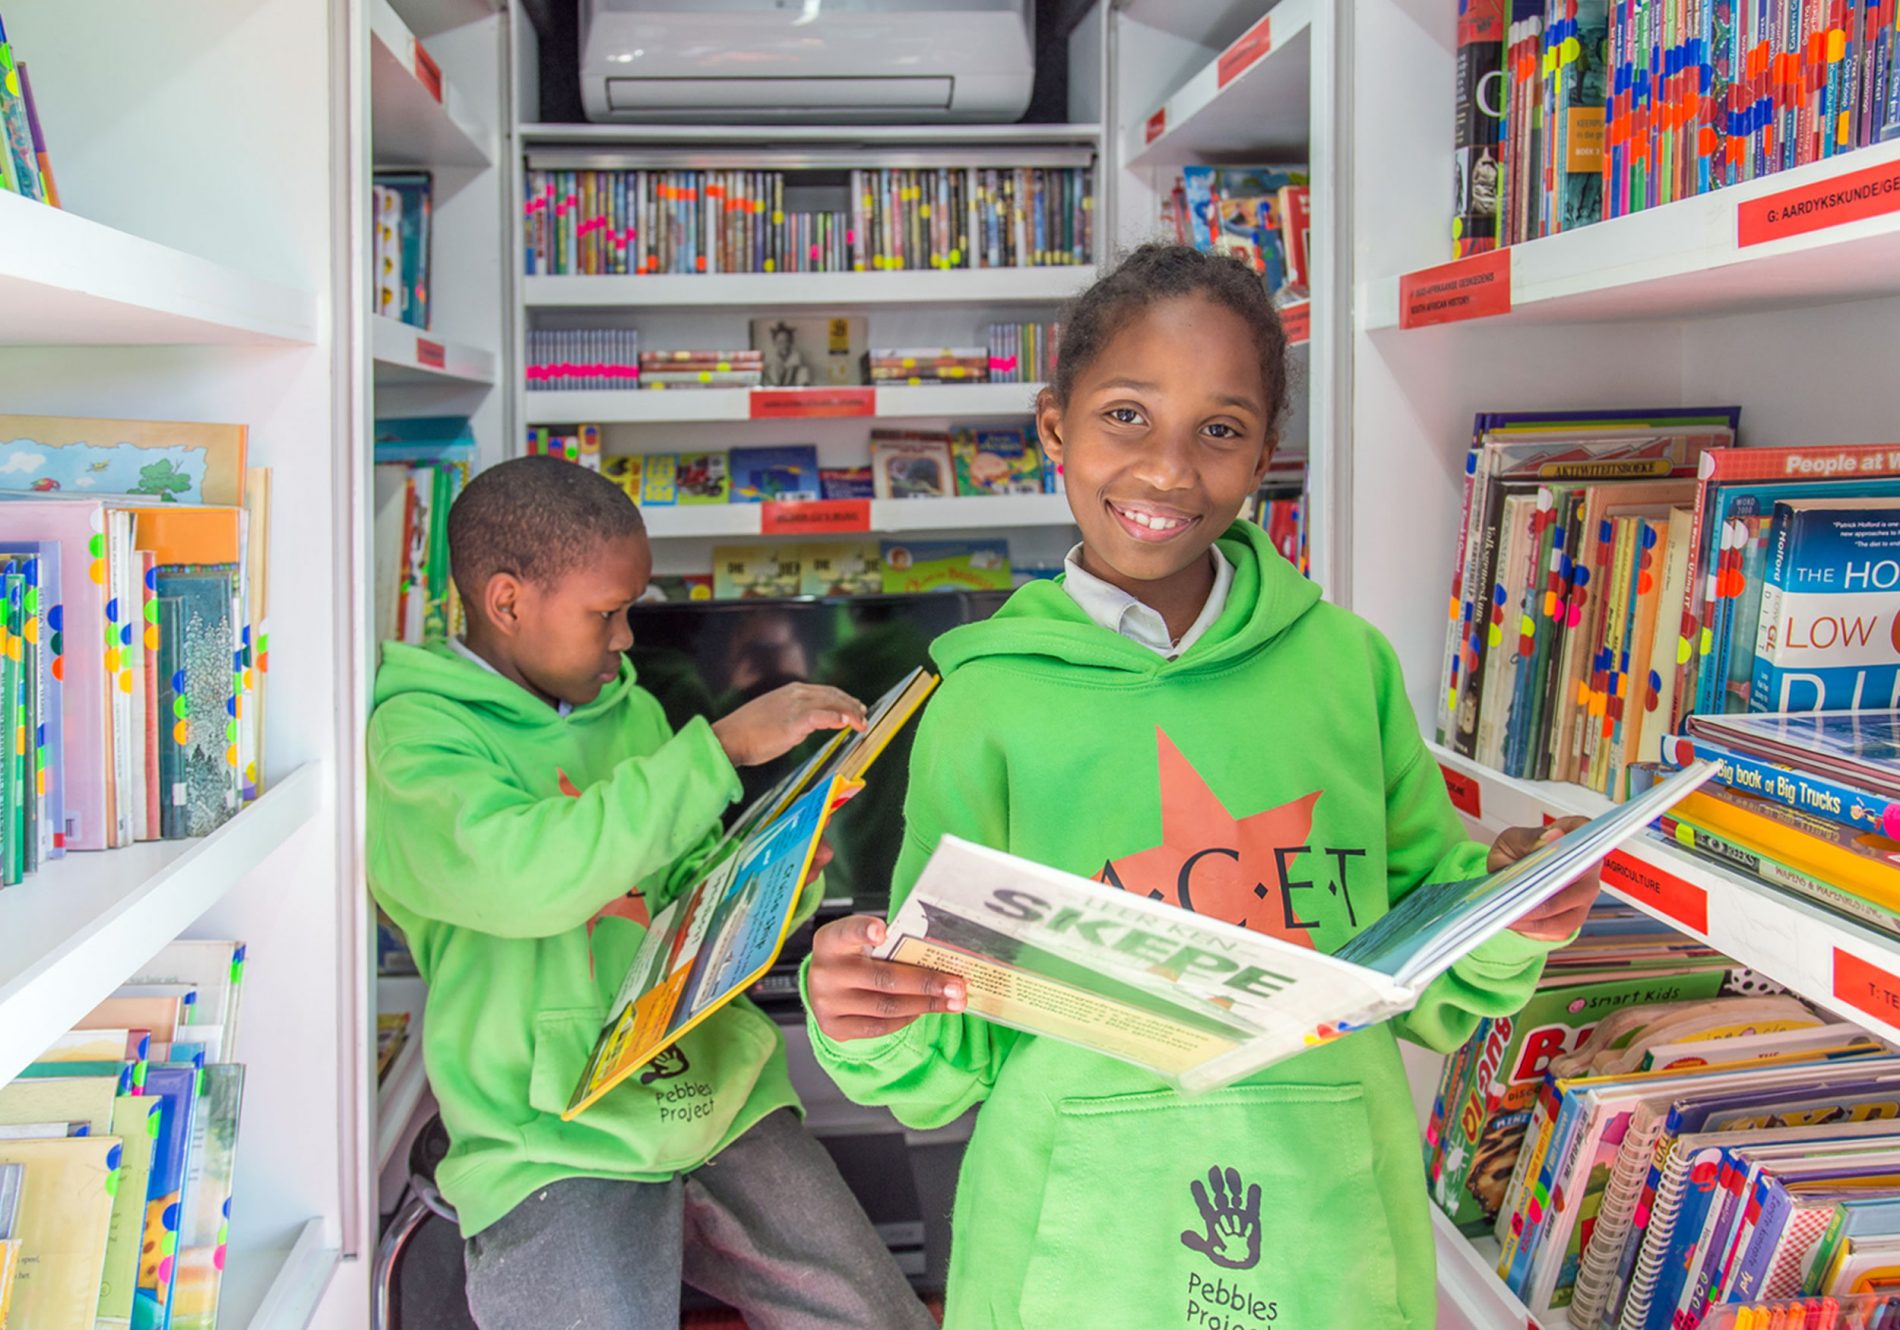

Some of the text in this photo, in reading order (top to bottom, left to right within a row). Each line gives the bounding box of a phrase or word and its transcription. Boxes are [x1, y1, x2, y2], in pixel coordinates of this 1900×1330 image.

[1788, 12, 1797, 51] Eastern
[1801, 5, 1811, 47] Gauteng
[1877, 45, 1887, 76] North
[1767, 209, 1779, 223] G:
[1786, 453, 1857, 476] People
[1861, 453, 1882, 471] at
[1694, 481, 1704, 513] People
[1773, 530, 1787, 582] Holford
[1685, 561, 1696, 593] Using
[1797, 567, 1835, 583] THE
[1786, 615, 1878, 649] LOW
[1717, 758, 1841, 814] Big book of Big Trucks
[983, 886, 1298, 1000] SKEPE
[1644, 986, 1681, 1002] Kids
[655, 1086, 713, 1106] Pebbles
[660, 1100, 715, 1122] Project
[1461, 1089, 1485, 1144] IQ
[1762, 1194, 1782, 1229] Eerste
[1188, 1271, 1278, 1321] Pebbles
